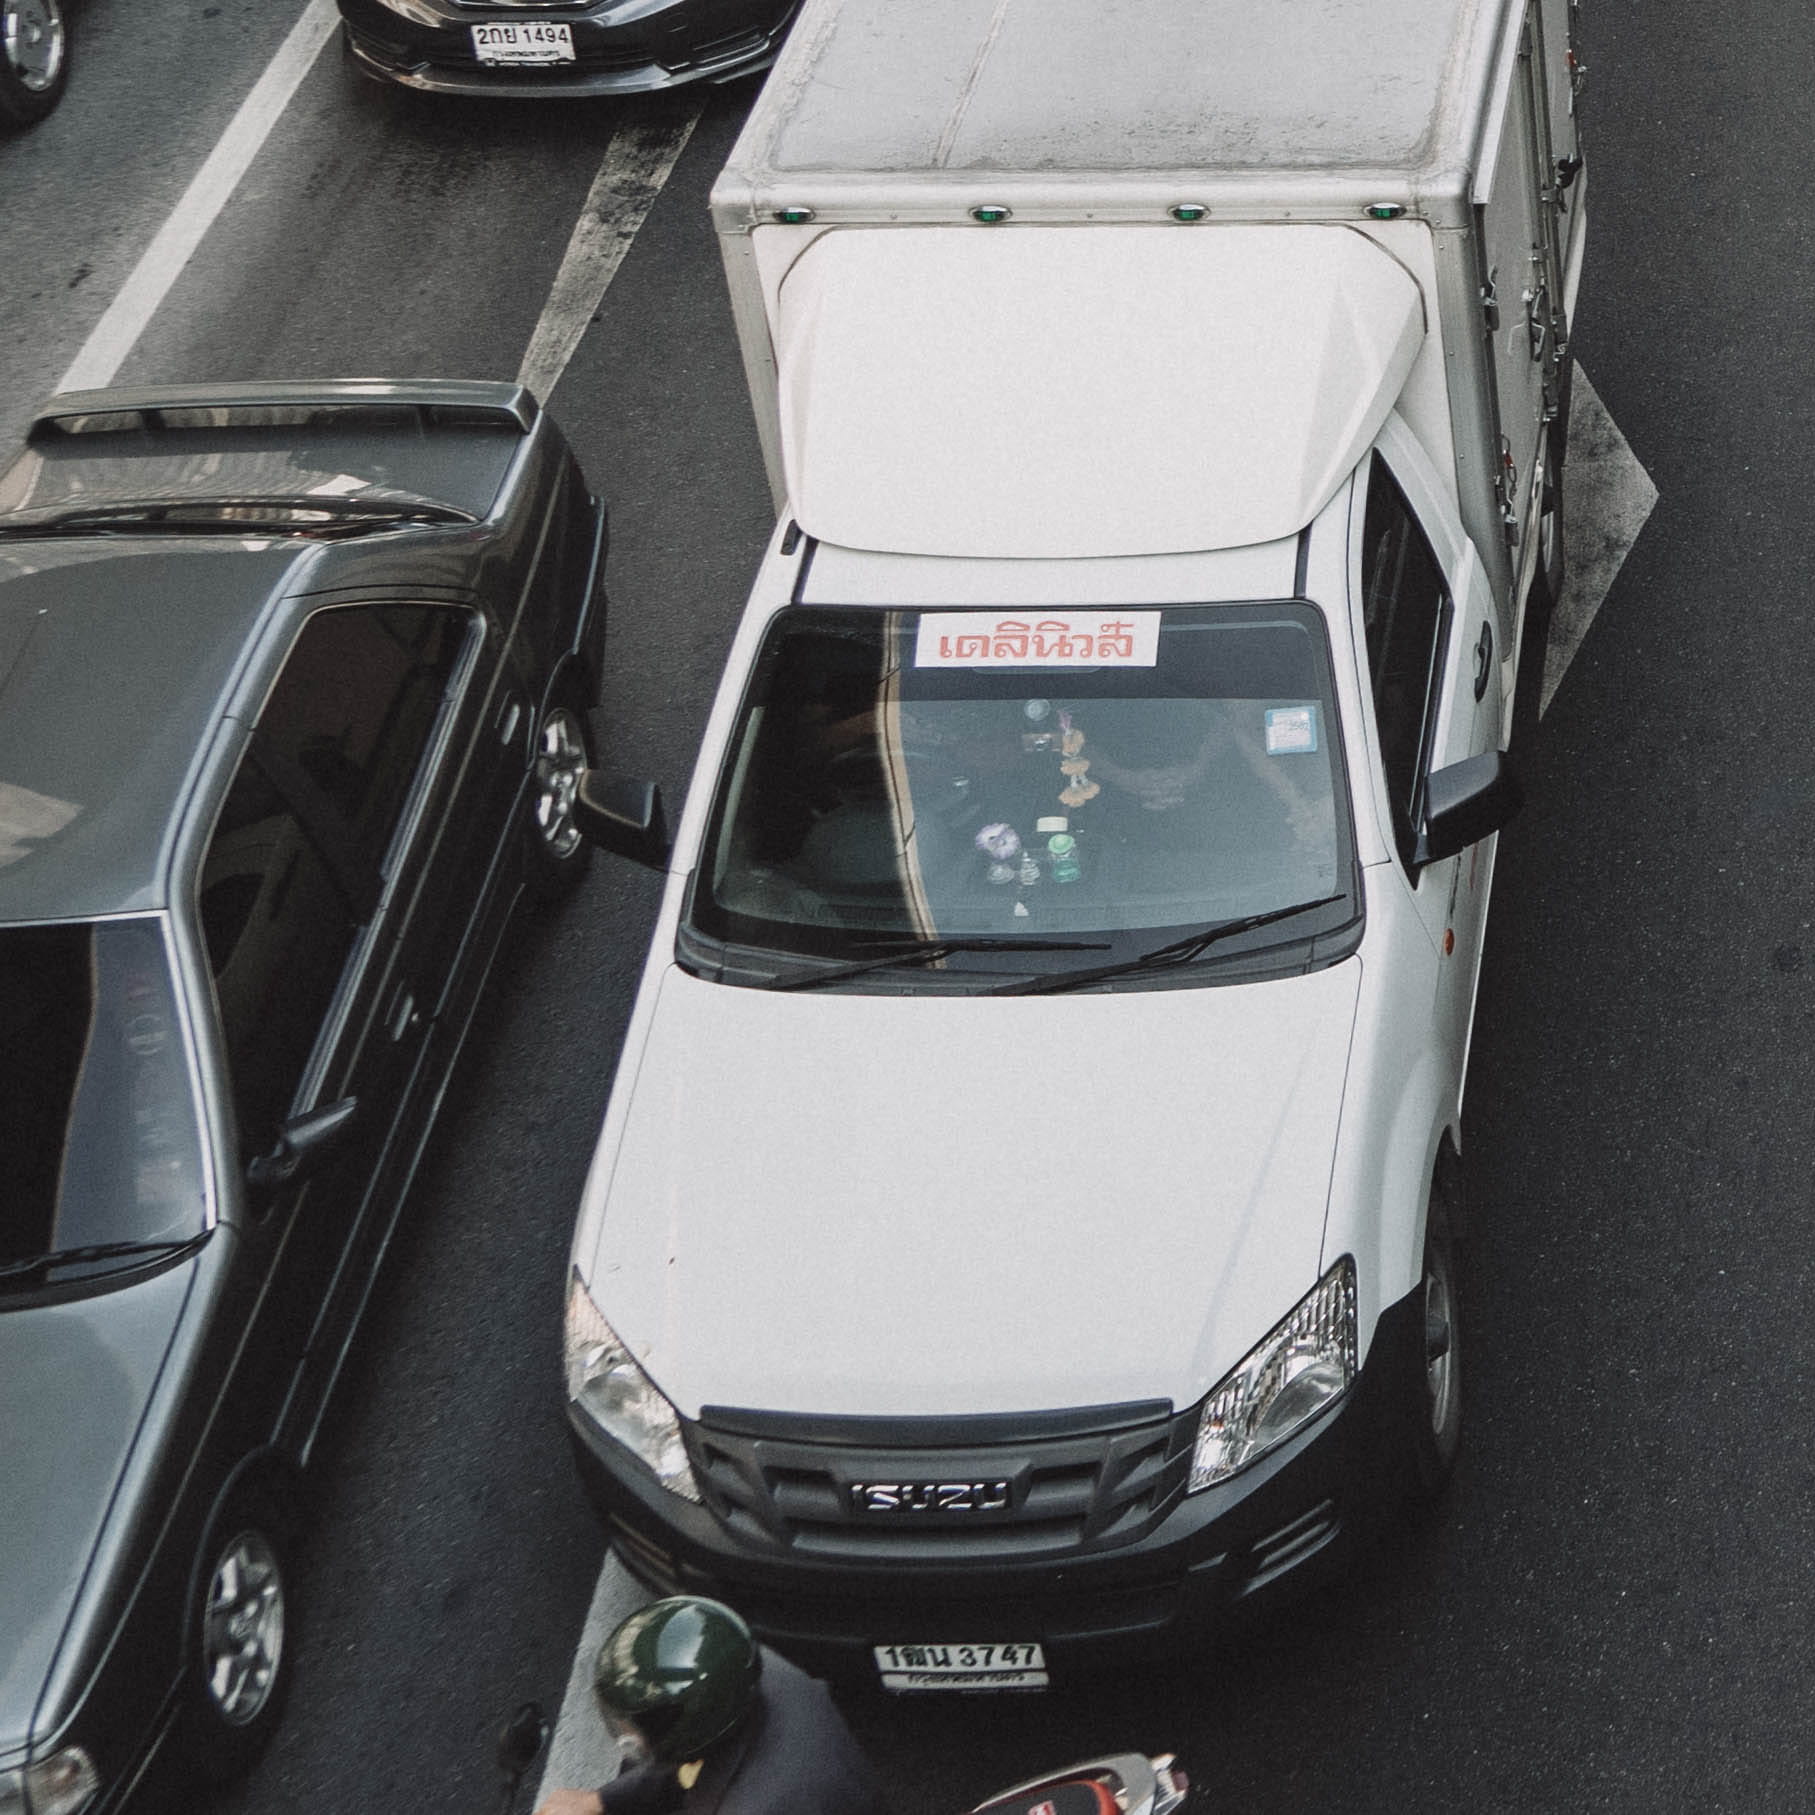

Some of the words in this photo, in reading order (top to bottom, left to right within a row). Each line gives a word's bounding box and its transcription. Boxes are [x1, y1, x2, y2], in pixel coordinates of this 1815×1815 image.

[523, 27, 569, 44] 1494
[938, 620, 1135, 659] เดลินิวส์
[851, 1482, 1007, 1512] ISUZU
[958, 1645, 1036, 1667] 3747
